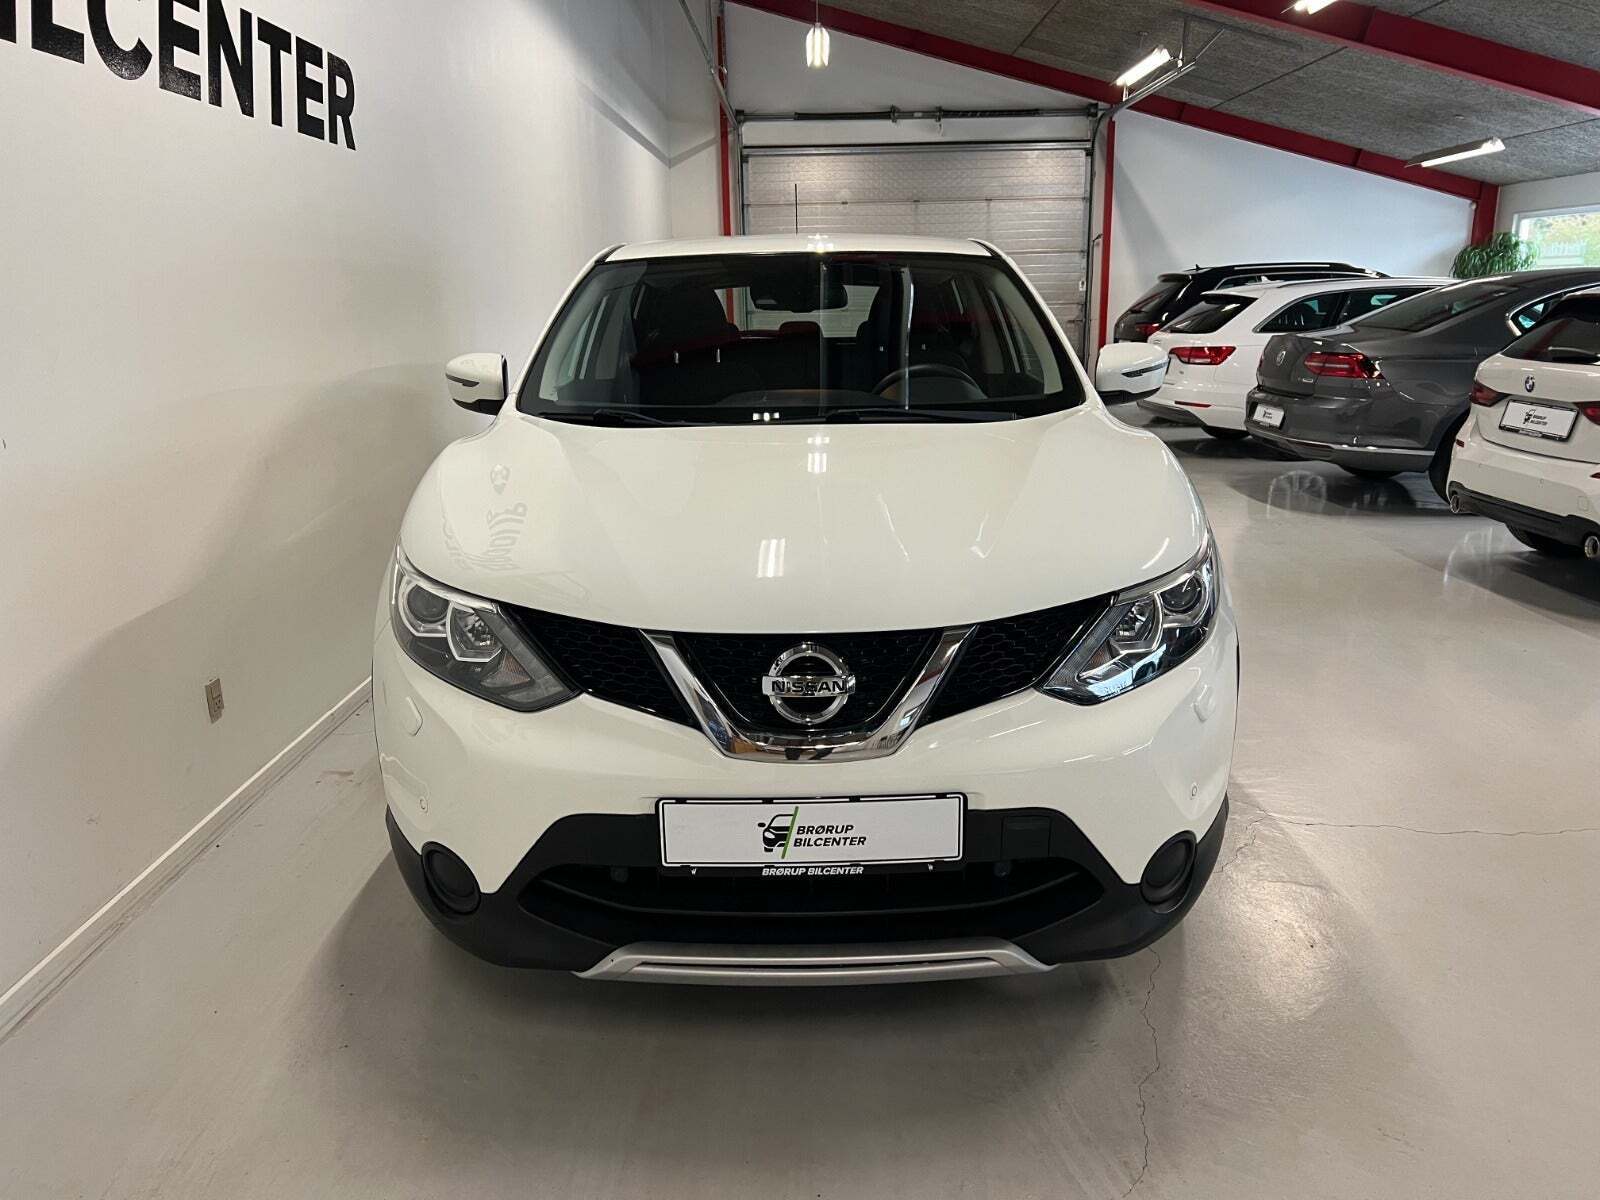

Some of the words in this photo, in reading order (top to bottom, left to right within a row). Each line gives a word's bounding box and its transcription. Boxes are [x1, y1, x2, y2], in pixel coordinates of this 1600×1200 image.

[0, 0, 356, 151] LCENTER
[771, 680, 845, 693] NISSAN
[796, 824, 854, 835] BRØRUP
[793, 836, 867, 847] BILCENTER
[762, 867, 806, 876] BRØRUP
[807, 866, 864, 875] BILCENTER
